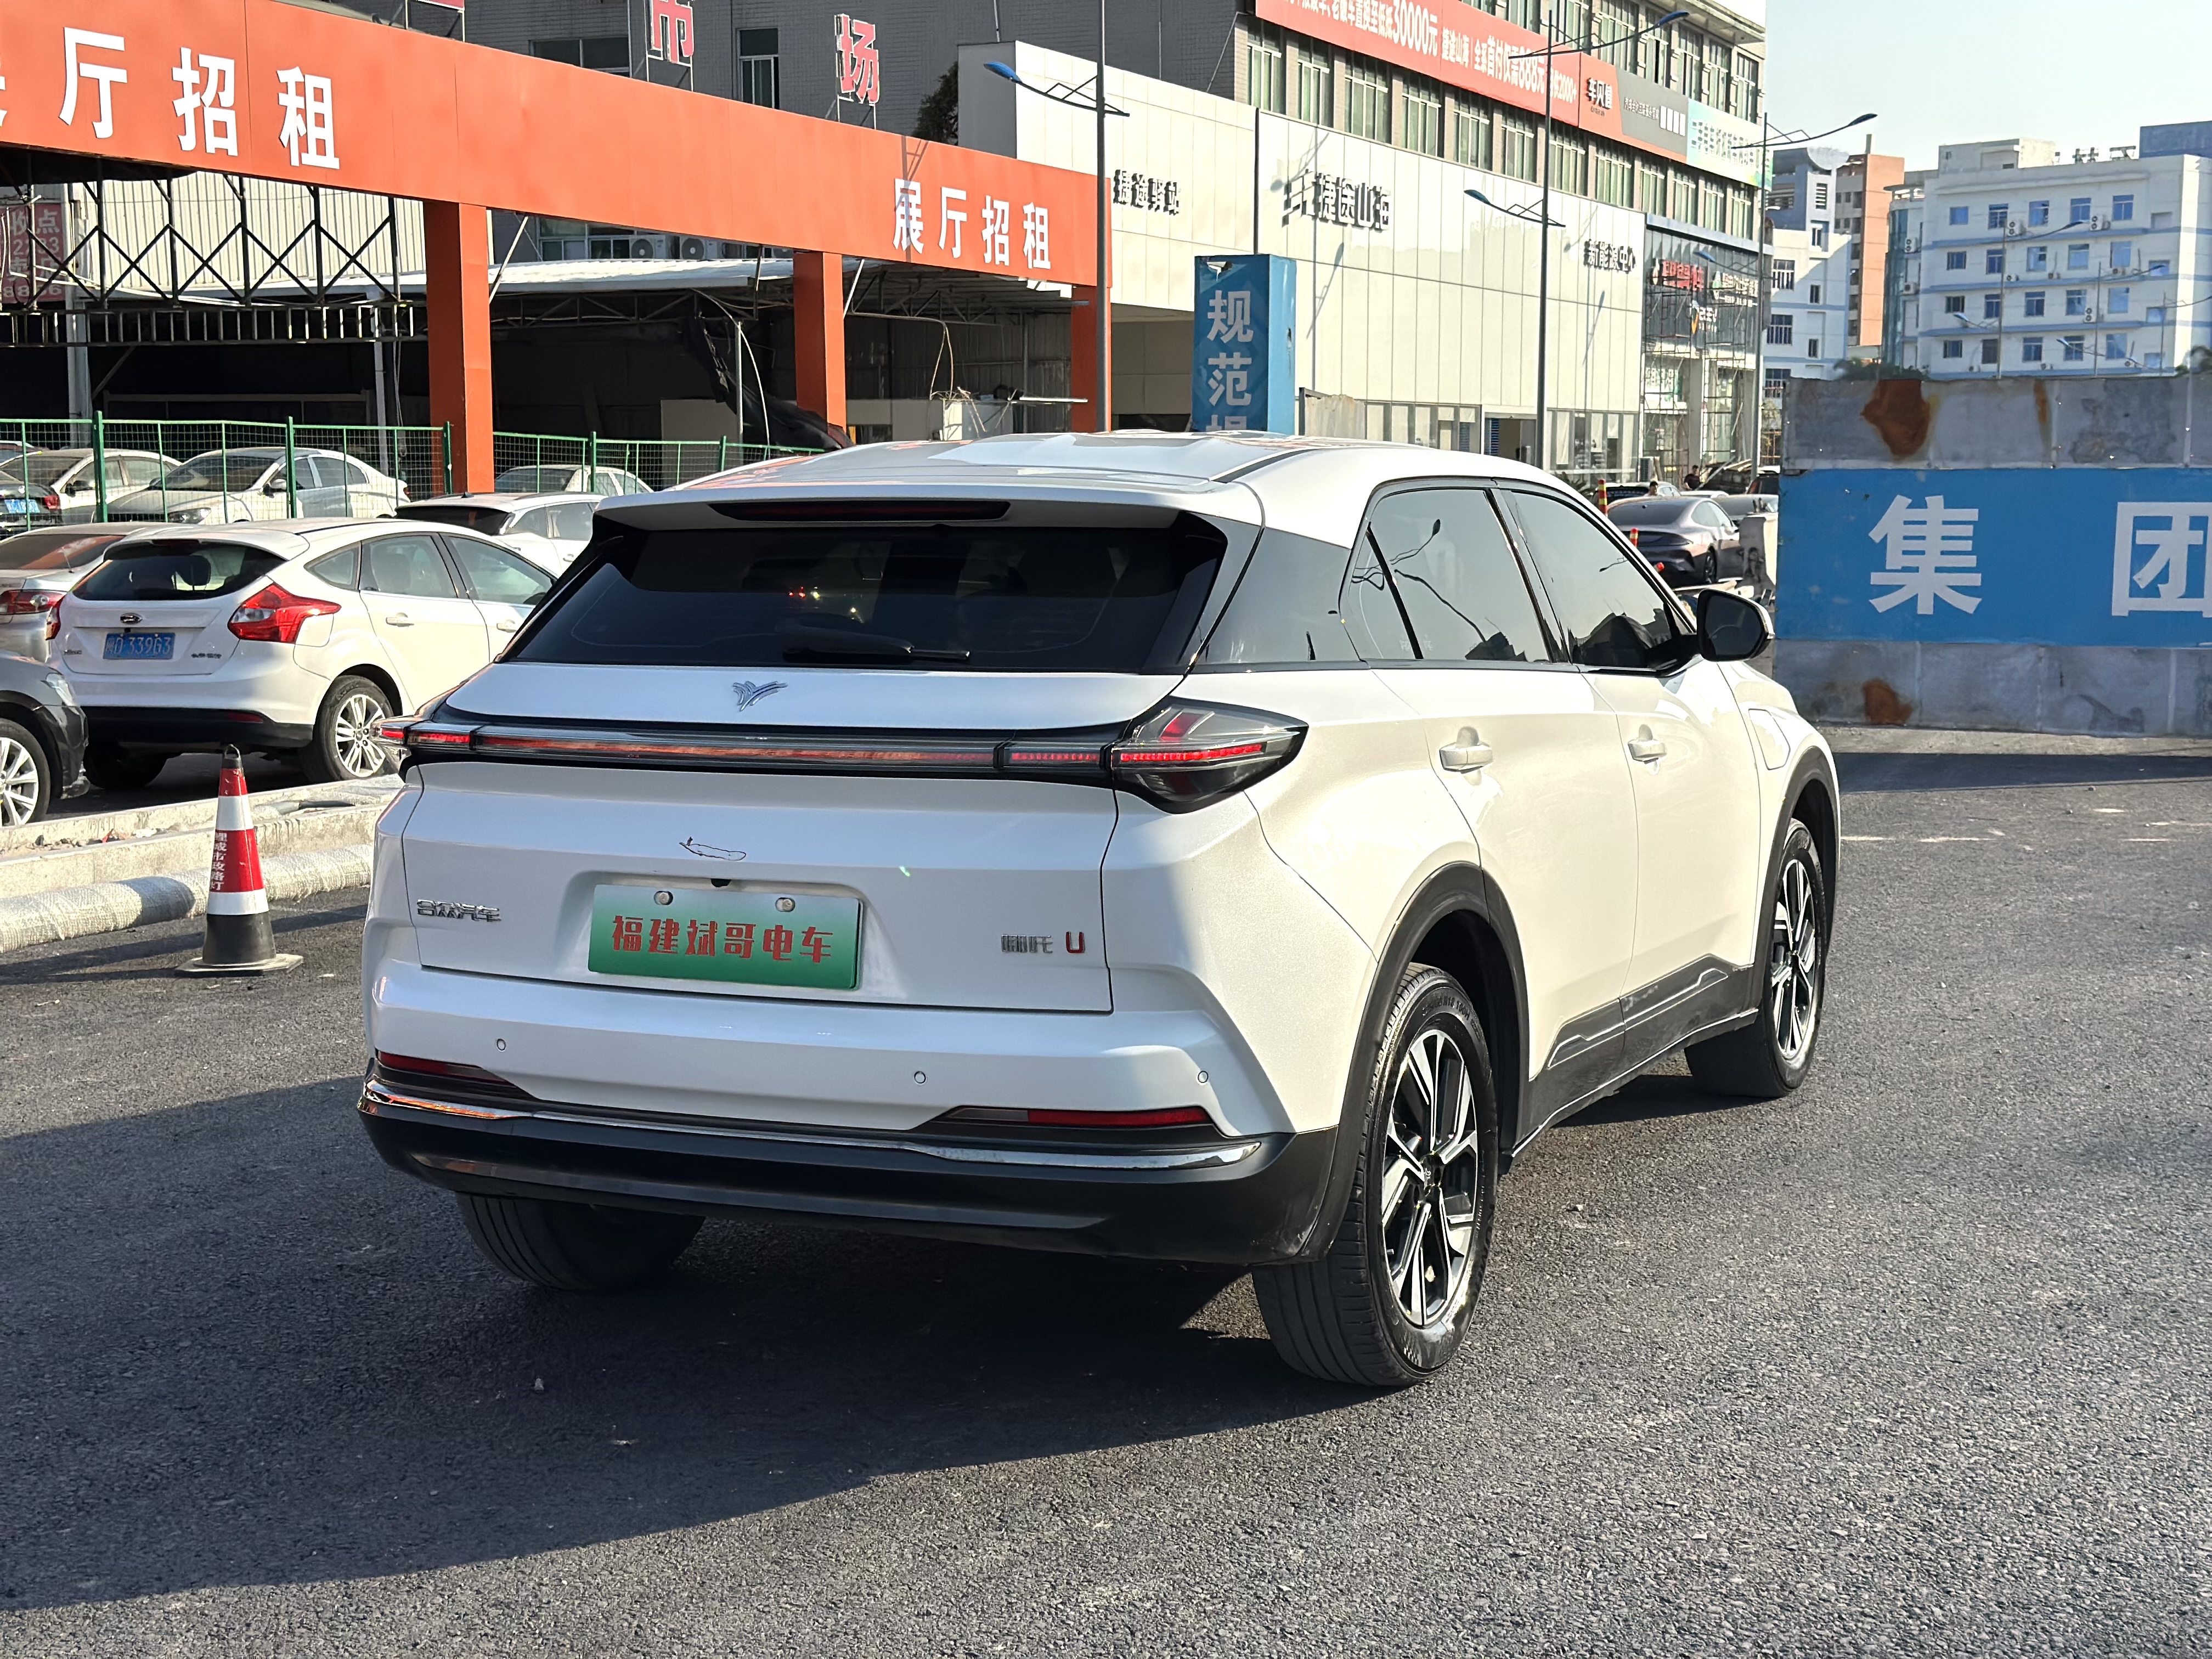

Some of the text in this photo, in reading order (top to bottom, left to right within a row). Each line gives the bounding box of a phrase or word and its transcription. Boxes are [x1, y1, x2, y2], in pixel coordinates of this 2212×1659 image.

[0, 27, 340, 170] 厅招租
[893, 178, 1051, 269] 展厅招租
[1114, 170, 1181, 216] 捷途驿站
[1868, 494, 2212, 618] 集团
[611, 915, 833, 963] 福建斌哥电车
[1066, 932, 1085, 953] U
